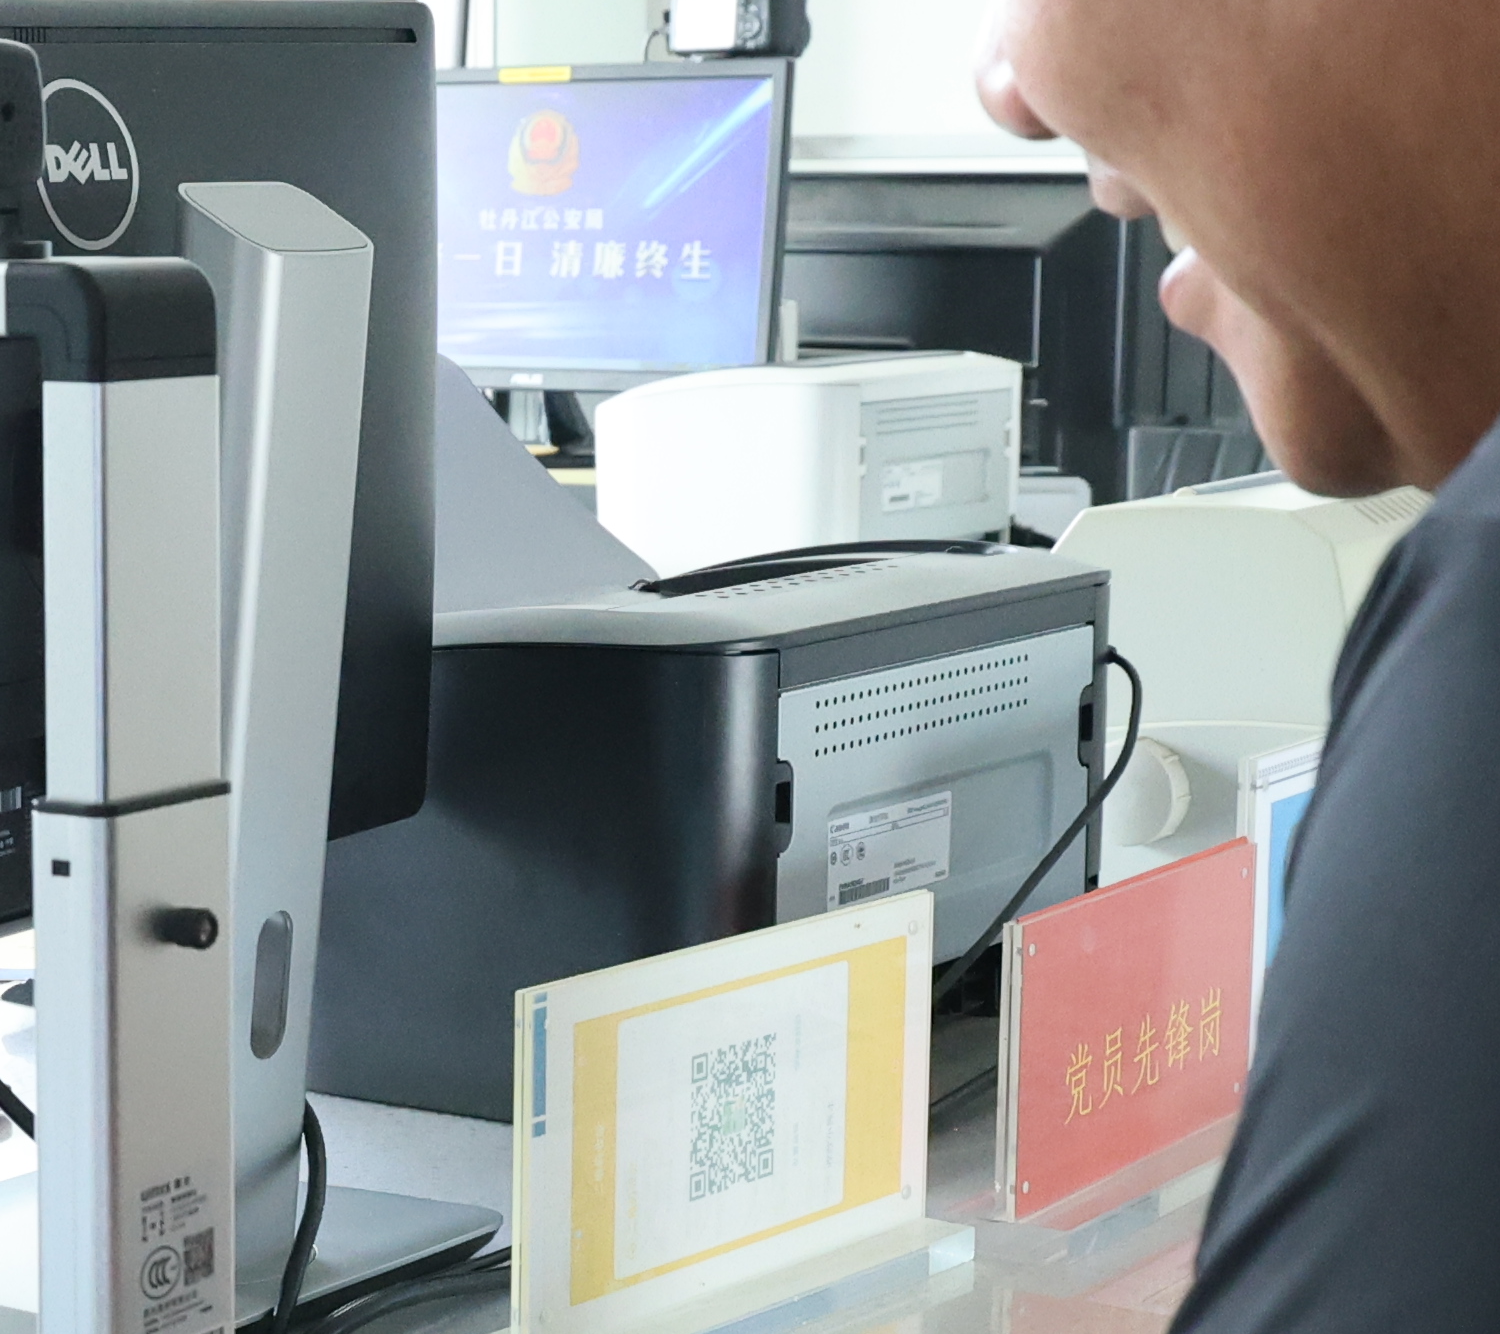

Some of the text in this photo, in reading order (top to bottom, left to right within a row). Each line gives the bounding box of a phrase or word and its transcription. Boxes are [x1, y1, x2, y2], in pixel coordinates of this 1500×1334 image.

[45, 141, 128, 185] DELL
[437, 240, 712, 279] 一日 清廉终生
[1064, 986, 1222, 1125] 党员先锋岗
